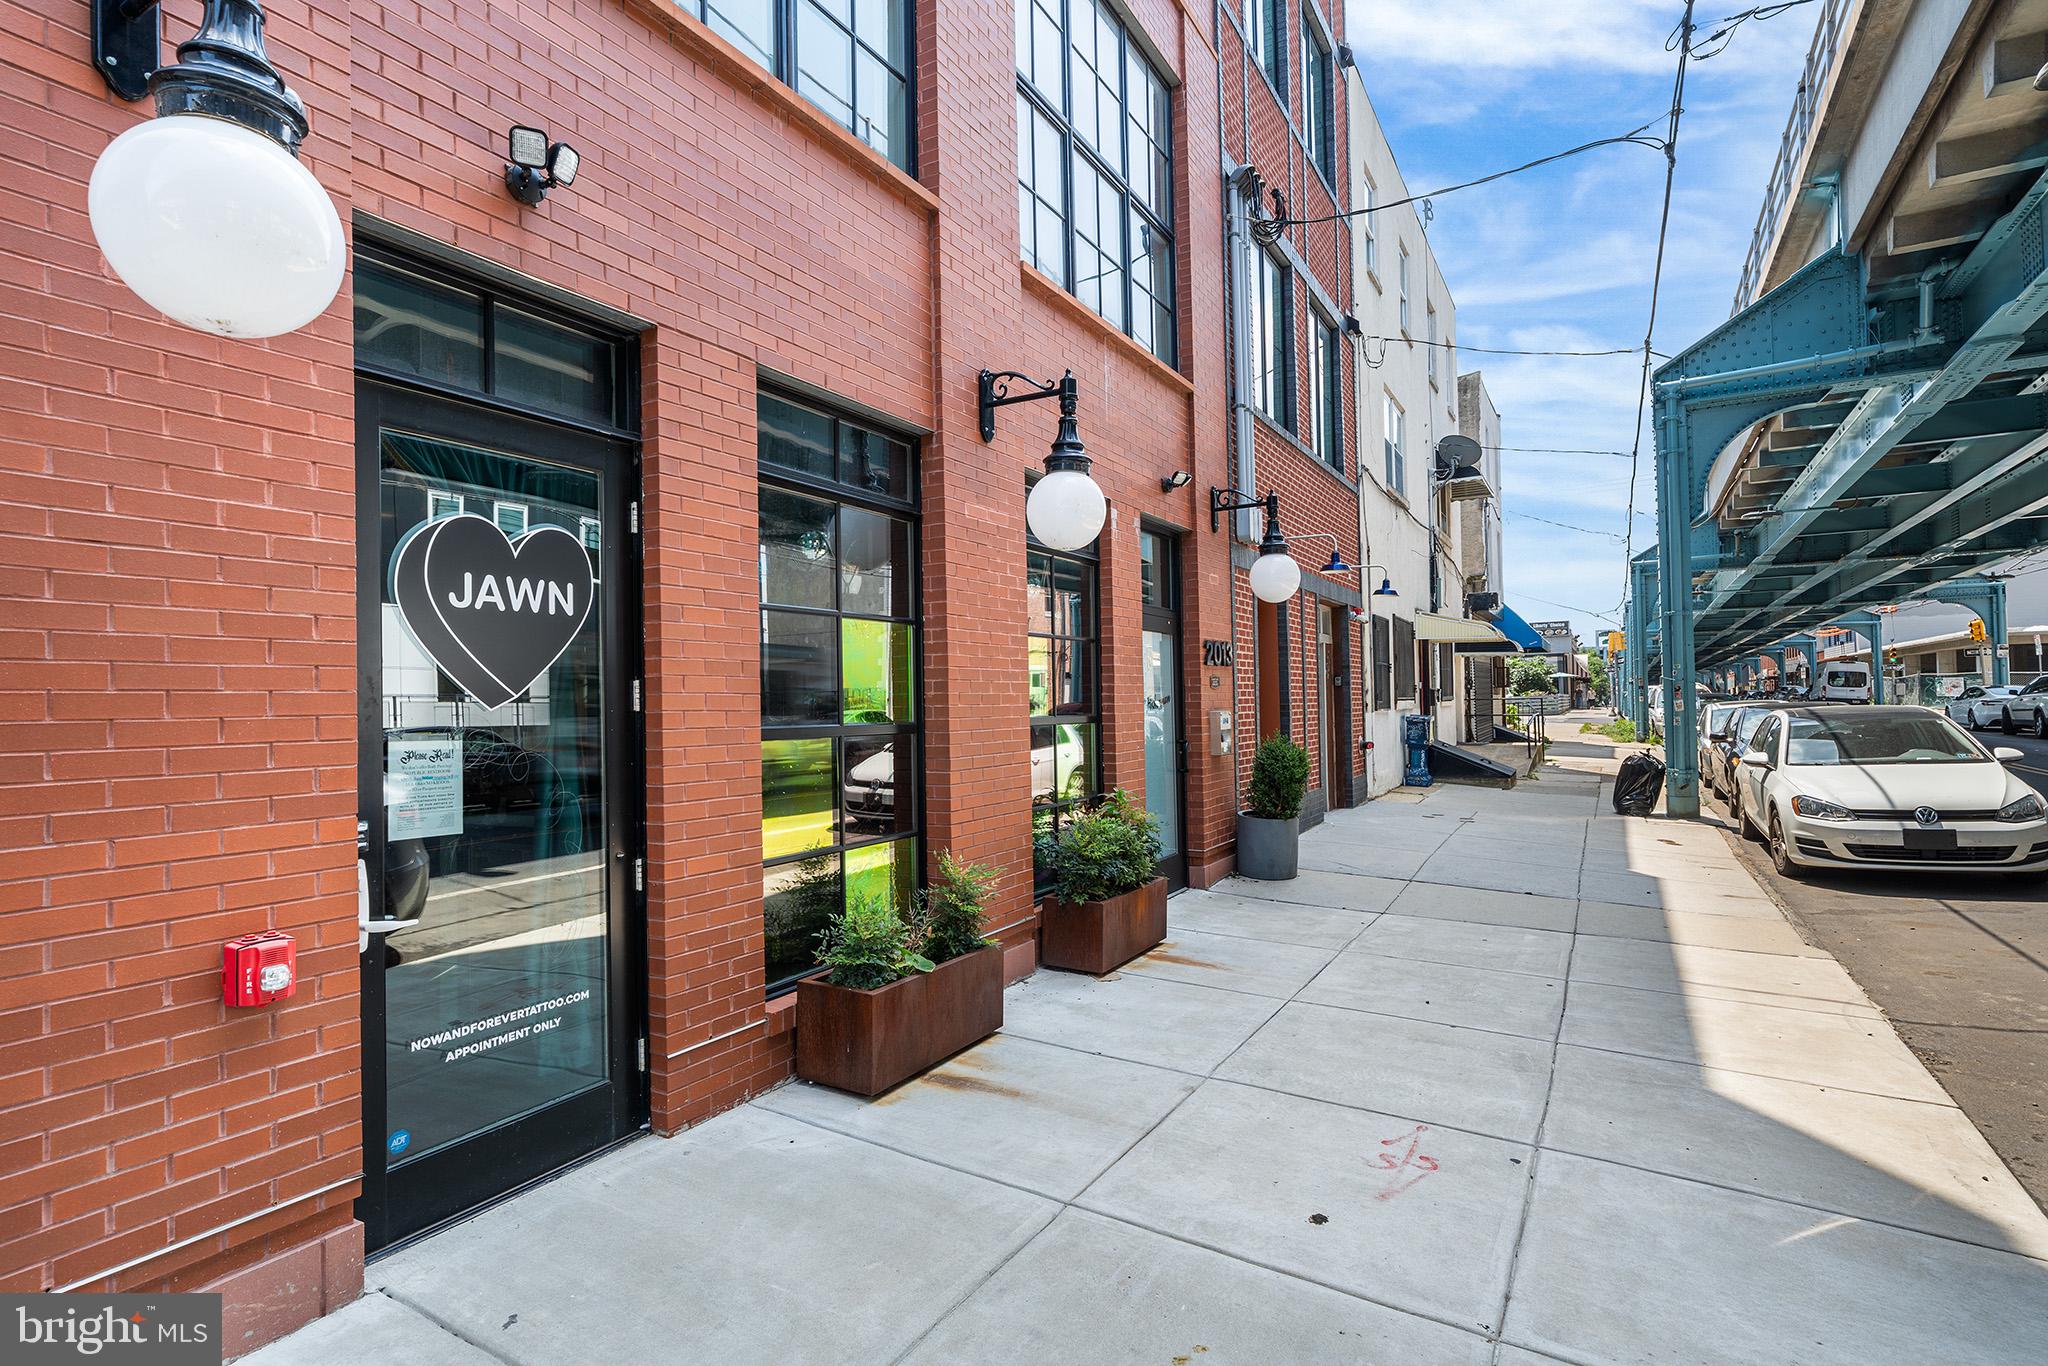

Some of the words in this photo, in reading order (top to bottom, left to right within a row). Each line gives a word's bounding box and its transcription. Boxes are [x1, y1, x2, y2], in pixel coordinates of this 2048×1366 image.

[448, 572, 575, 617] JAWN
[1204, 640, 1233, 667] 2013
[400, 750, 427, 764] Please
[429, 748, 454, 763] Read!
[410, 990, 590, 1052] NOWANDFOREVERTATTOO.COM
[445, 1026, 531, 1063] APPOINTMENT
[533, 1017, 562, 1034] ONLY
[390, 1134, 407, 1148] ADT
